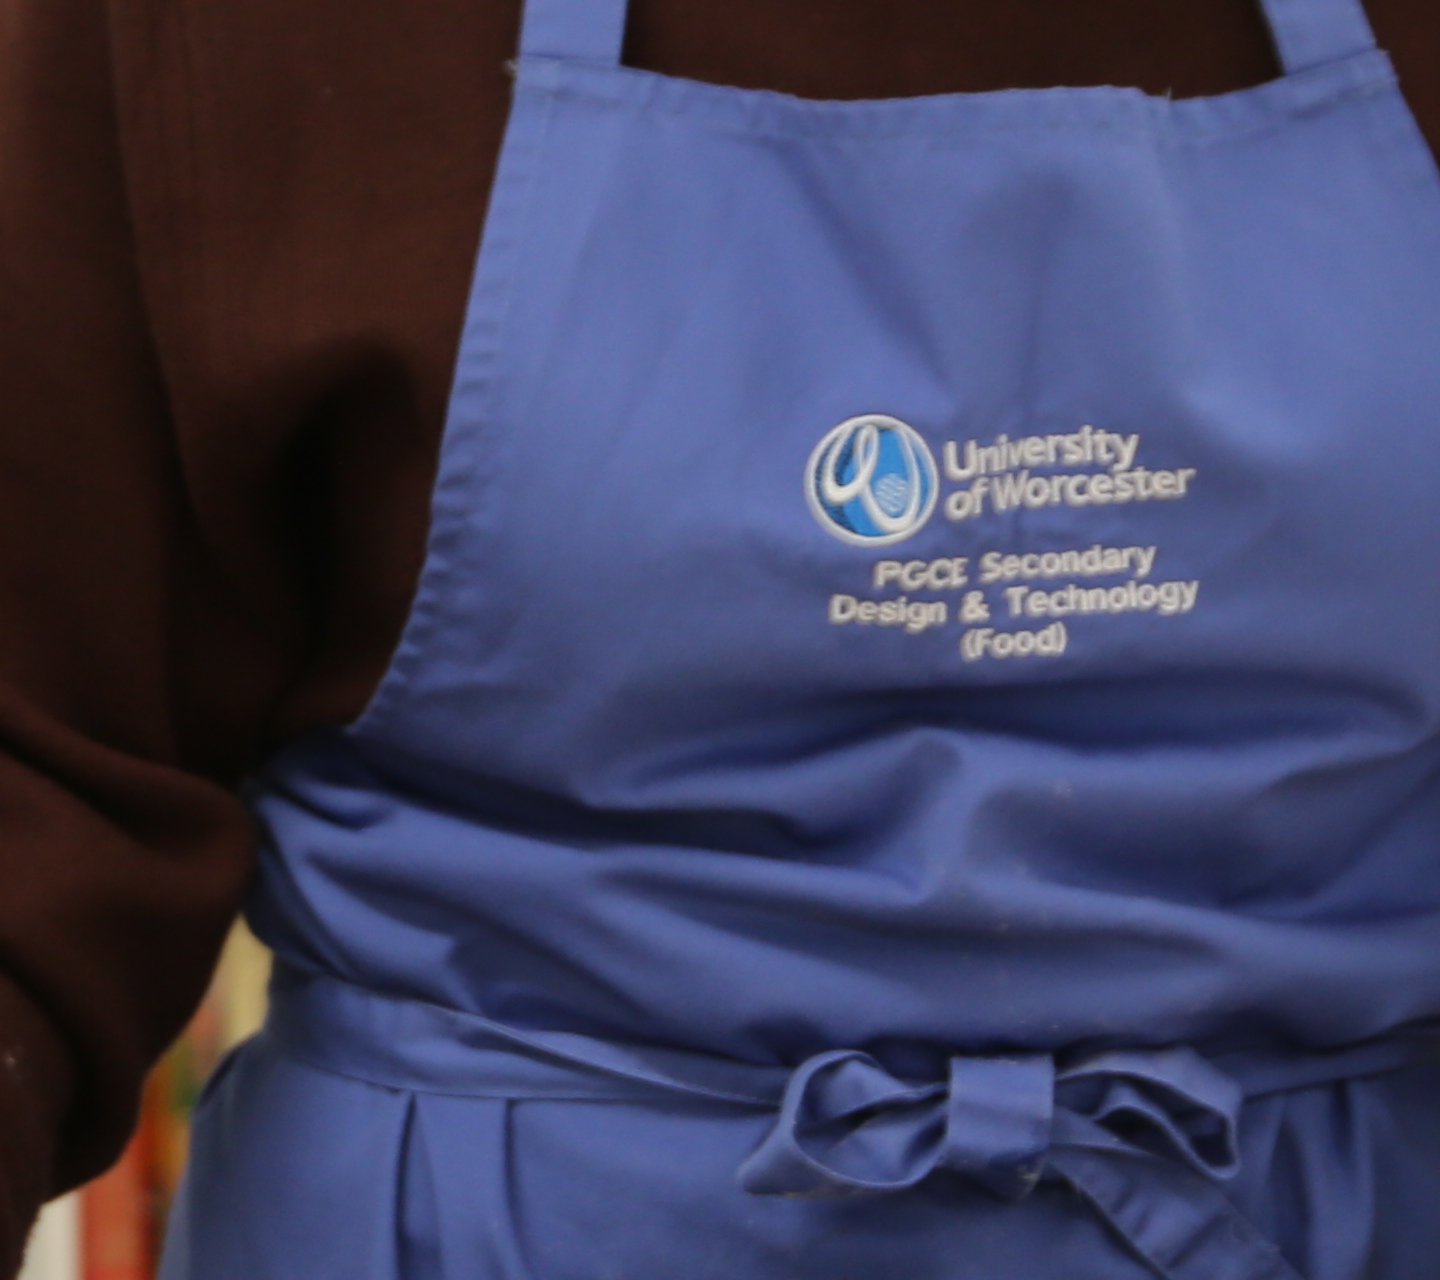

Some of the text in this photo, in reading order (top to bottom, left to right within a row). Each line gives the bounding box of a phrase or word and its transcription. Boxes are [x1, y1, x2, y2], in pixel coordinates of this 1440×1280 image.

[943, 425, 1139, 480] University
[944, 467, 1197, 520] of Worcester
[873, 545, 1157, 591] PGCE Secondary
[829, 579, 1200, 631] Design & Technology
[960, 622, 1068, 662] (Food)
